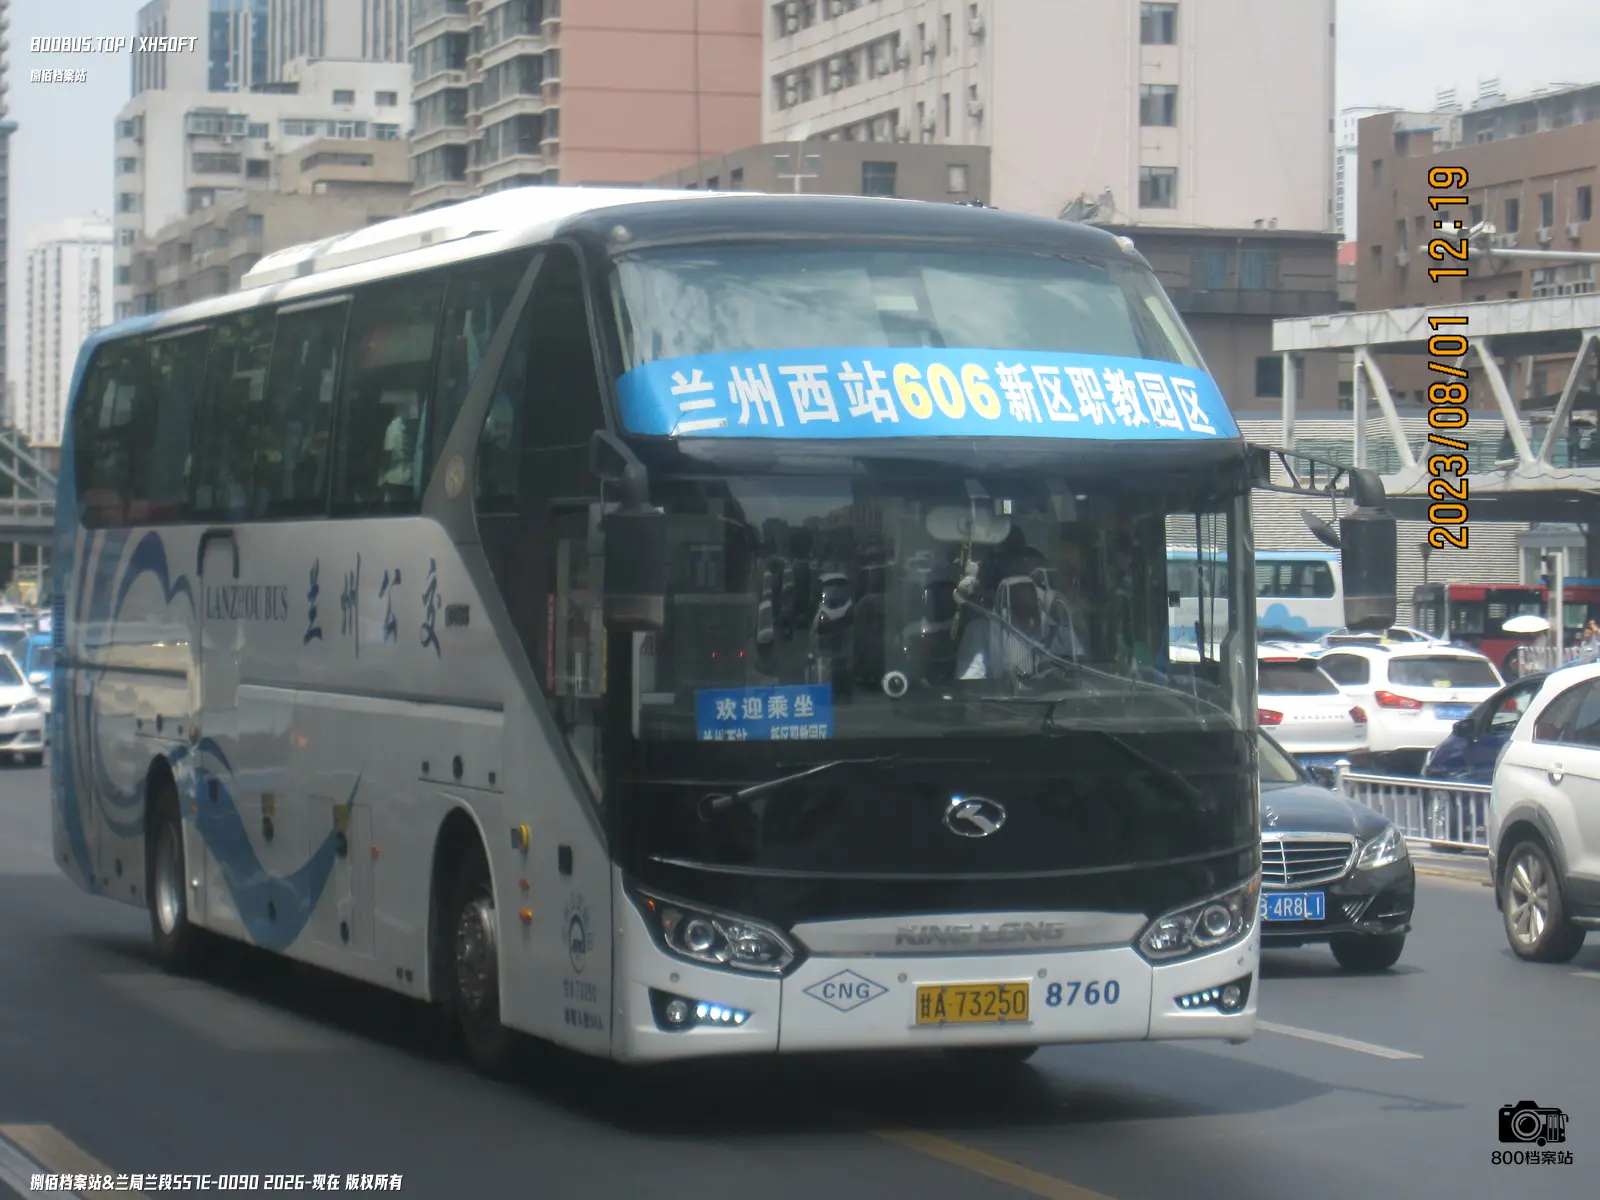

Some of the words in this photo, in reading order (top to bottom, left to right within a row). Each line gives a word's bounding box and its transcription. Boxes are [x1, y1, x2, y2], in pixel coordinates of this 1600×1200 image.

[206, 585, 261, 621] LANZHOU
[264, 585, 289, 622] BUS
[303, 552, 442, 660] 兰州公交
[715, 694, 814, 721] 欢迎乘坐
[895, 924, 974, 945] KING
[978, 922, 1066, 943] LONG
[822, 982, 870, 999] CNG
[1045, 980, 1120, 1007] 8760
